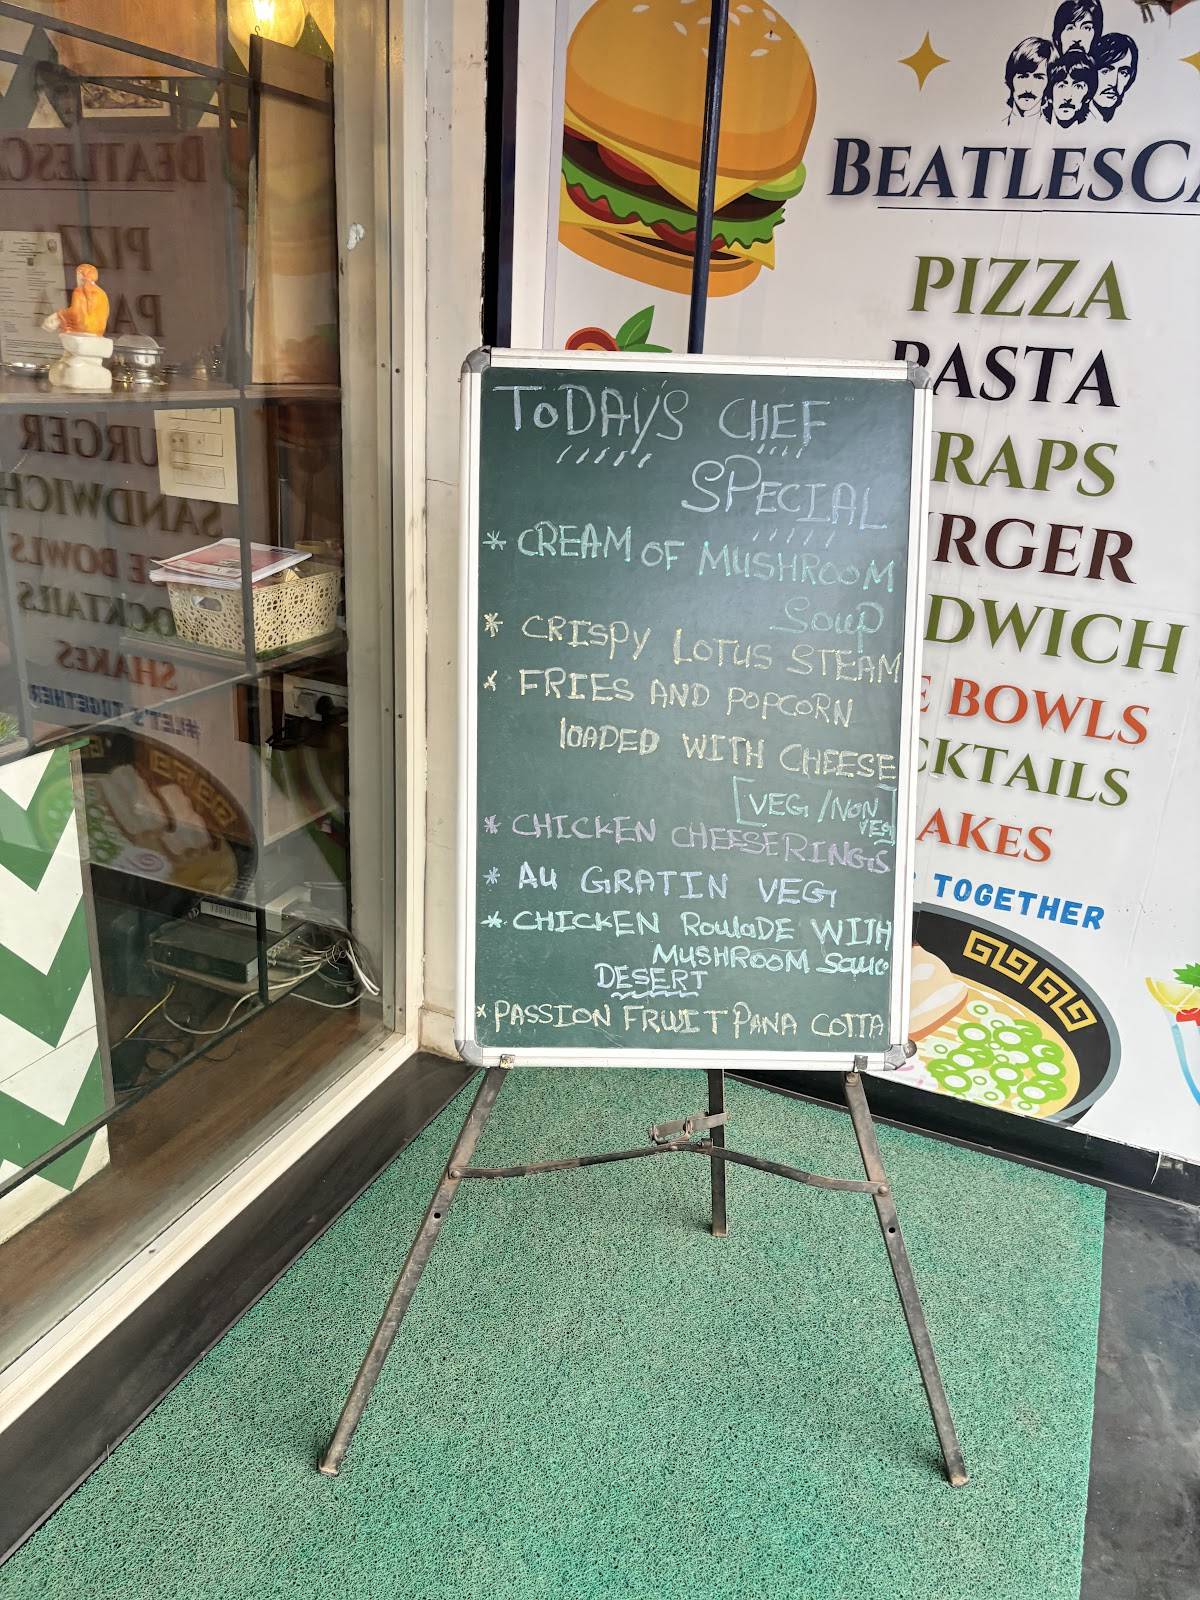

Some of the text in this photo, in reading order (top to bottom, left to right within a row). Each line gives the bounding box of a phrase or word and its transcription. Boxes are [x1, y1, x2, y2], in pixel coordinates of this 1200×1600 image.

[907, 255, 1132, 321] PIZZA
[719, 397, 830, 447] CHEF
[930, 430, 1118, 497] RAPS
[681, 455, 888, 530] SPECIAL
[517, 521, 895, 592] CREAM OF MUSHROOM
[928, 511, 1137, 584] RGER
[924, 593, 1189, 674] DWICH
[519, 667, 635, 702] FRIES
[650, 678, 710, 709] AND
[786, 643, 902, 684] STEAM
[948, 677, 1151, 745] BOWLS
[683, 733, 765, 769] WITH
[779, 743, 897, 780] CHEESE
[511, 813, 657, 845] CHICKEN
[916, 807, 1053, 863] AKES
[581, 865, 728, 901] GRATIN
[758, 876, 837, 908] VEG
[933, 873, 1106, 931] TOGETHER
[512, 910, 660, 938] CHICKEN
[811, 916, 893, 952] WITH
[594, 962, 708, 991] DESERT
[652, 943, 811, 975] MUSHROOM
[493, 1000, 612, 1034] PASSION
[623, 1004, 729, 1036] FRUIT
[732, 1001, 798, 1040] PANA
